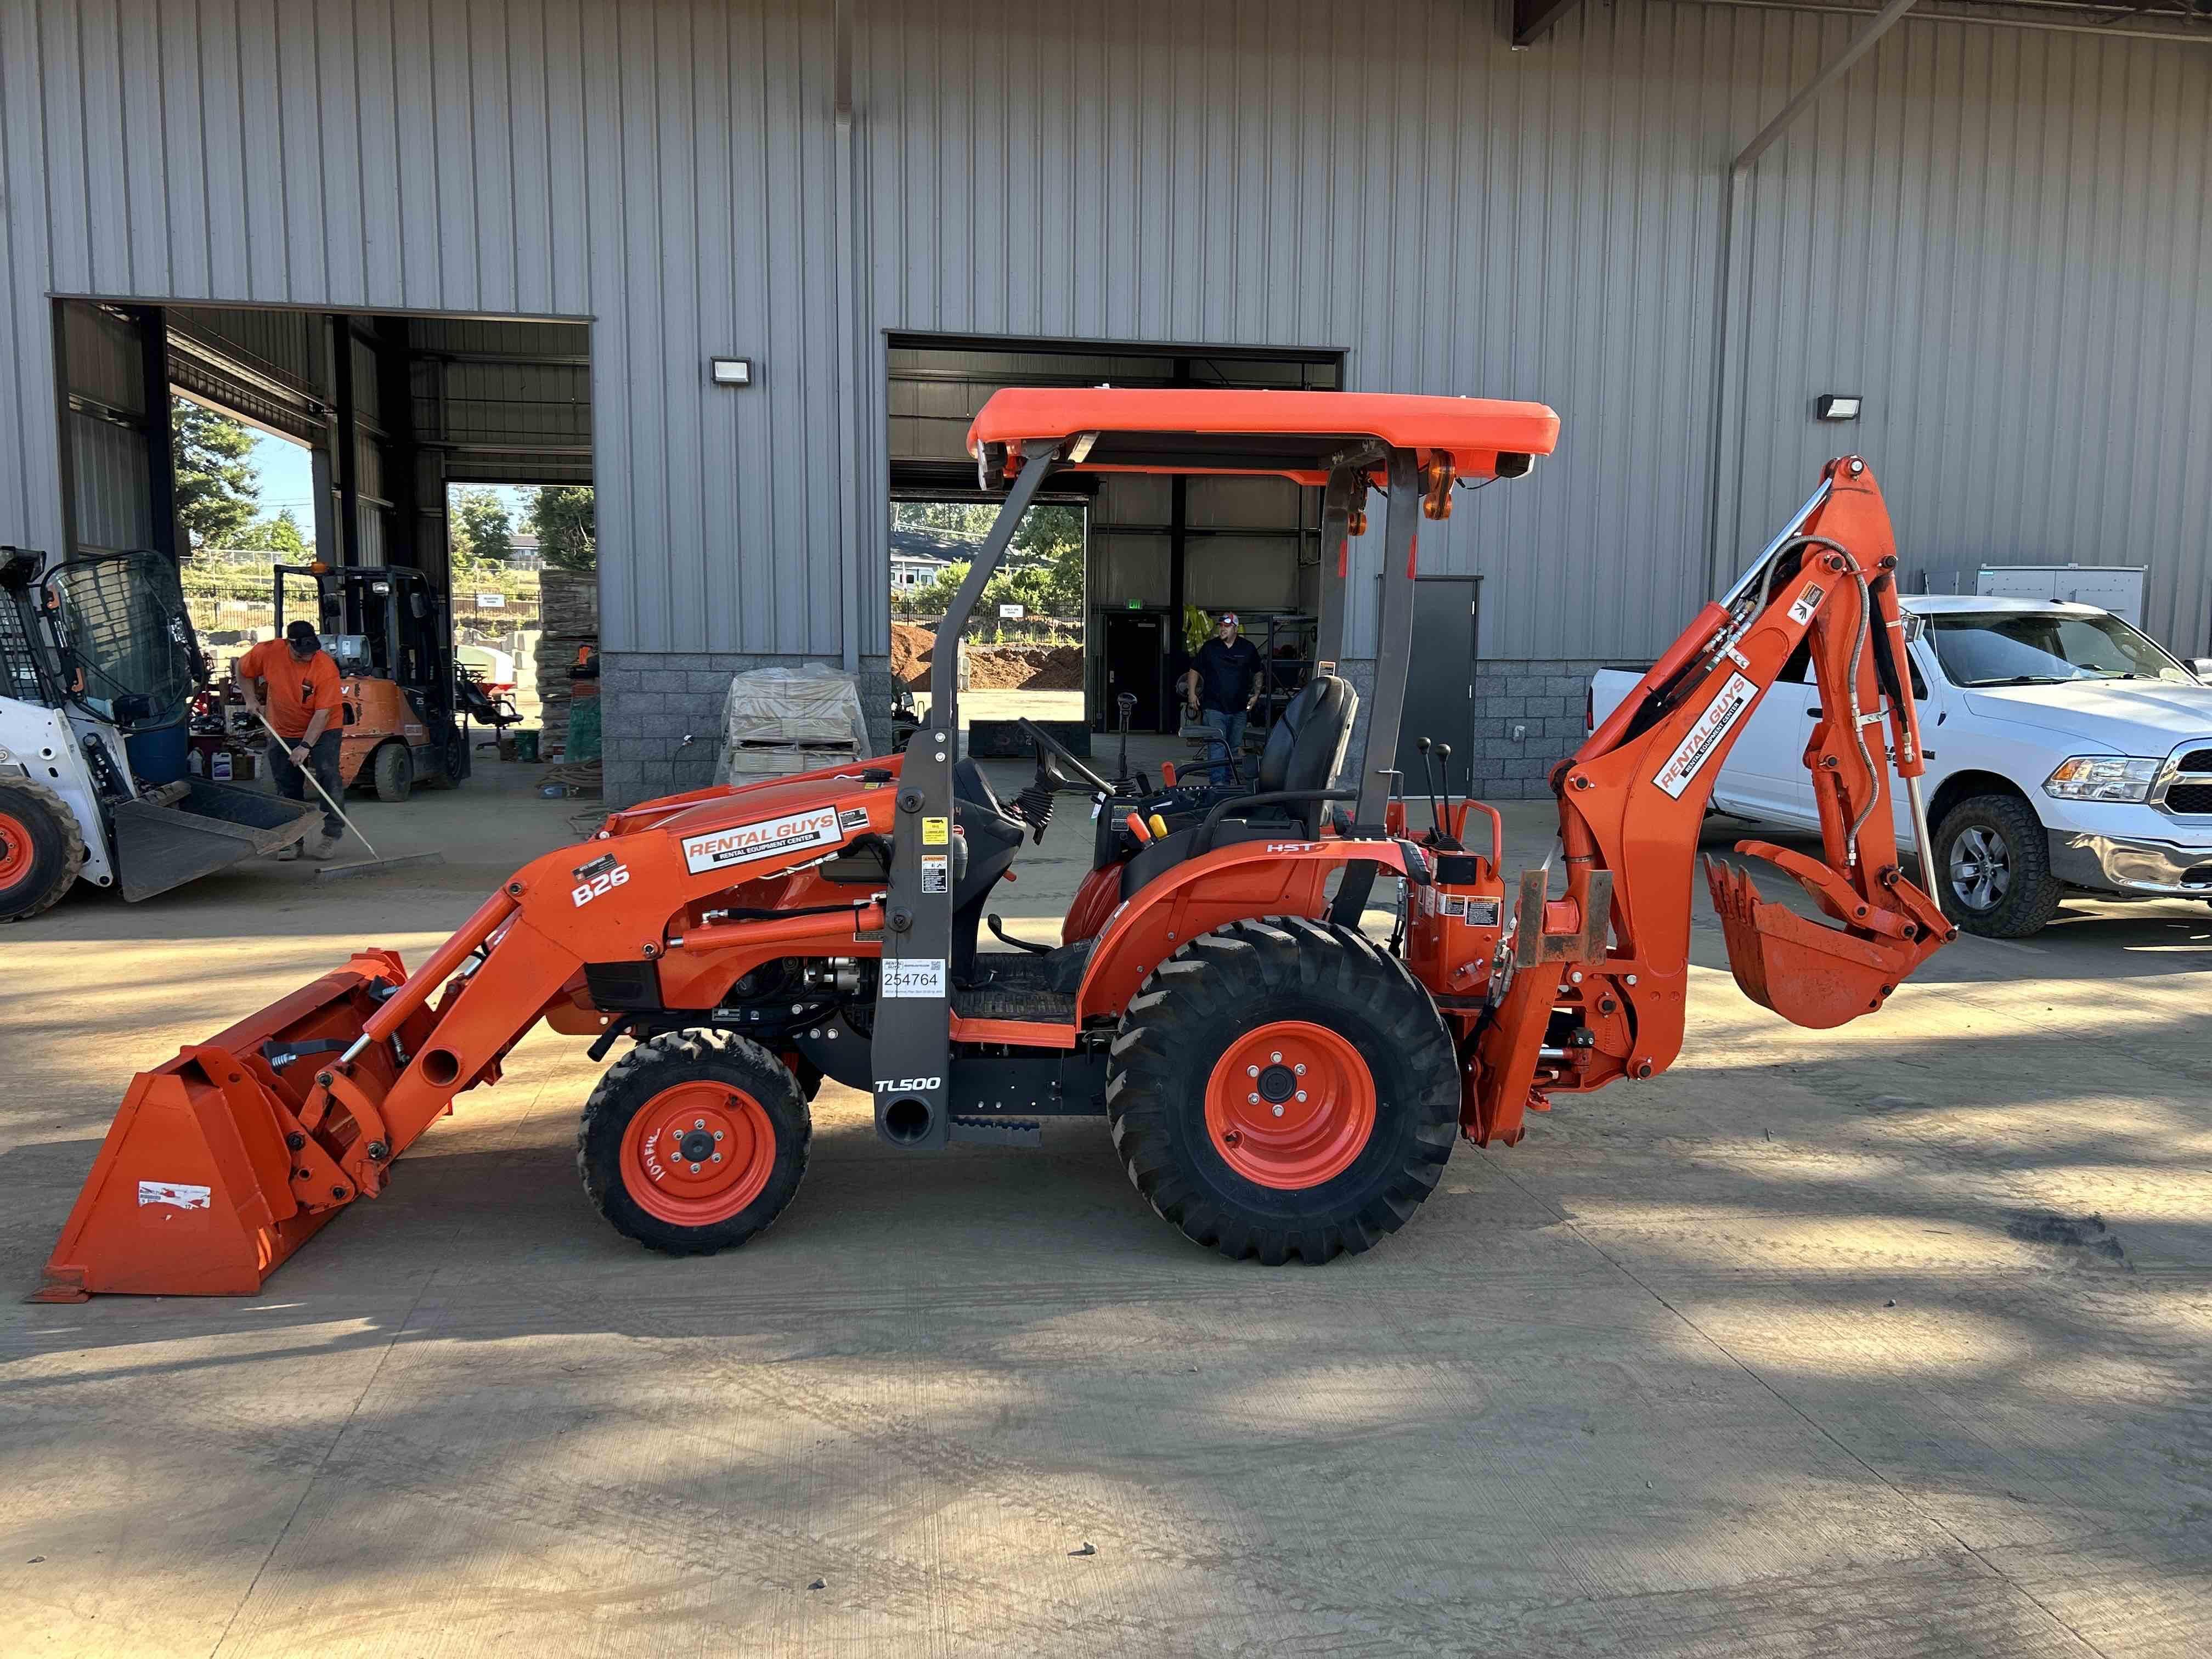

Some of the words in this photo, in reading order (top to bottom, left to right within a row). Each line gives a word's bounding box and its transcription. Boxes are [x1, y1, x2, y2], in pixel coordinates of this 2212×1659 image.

[1661, 725, 1712, 788] RENTAL
[1709, 678, 1745, 725] GUYS
[1685, 753, 1702, 772] RENTAL
[1700, 722, 1724, 753] EQUIPMENT
[1722, 702, 1740, 723] CENTER
[689, 830, 772, 857] RENTAL
[776, 814, 834, 838] GUYS
[719, 848, 746, 860] RENTAL
[746, 839, 787, 854] EQUIPMENT
[787, 833, 815, 845] CENTER
[1267, 843, 1313, 851] HST
[571, 864, 630, 908] B26
[884, 974, 938, 986] 254764
[874, 1077, 941, 1093] TL500
